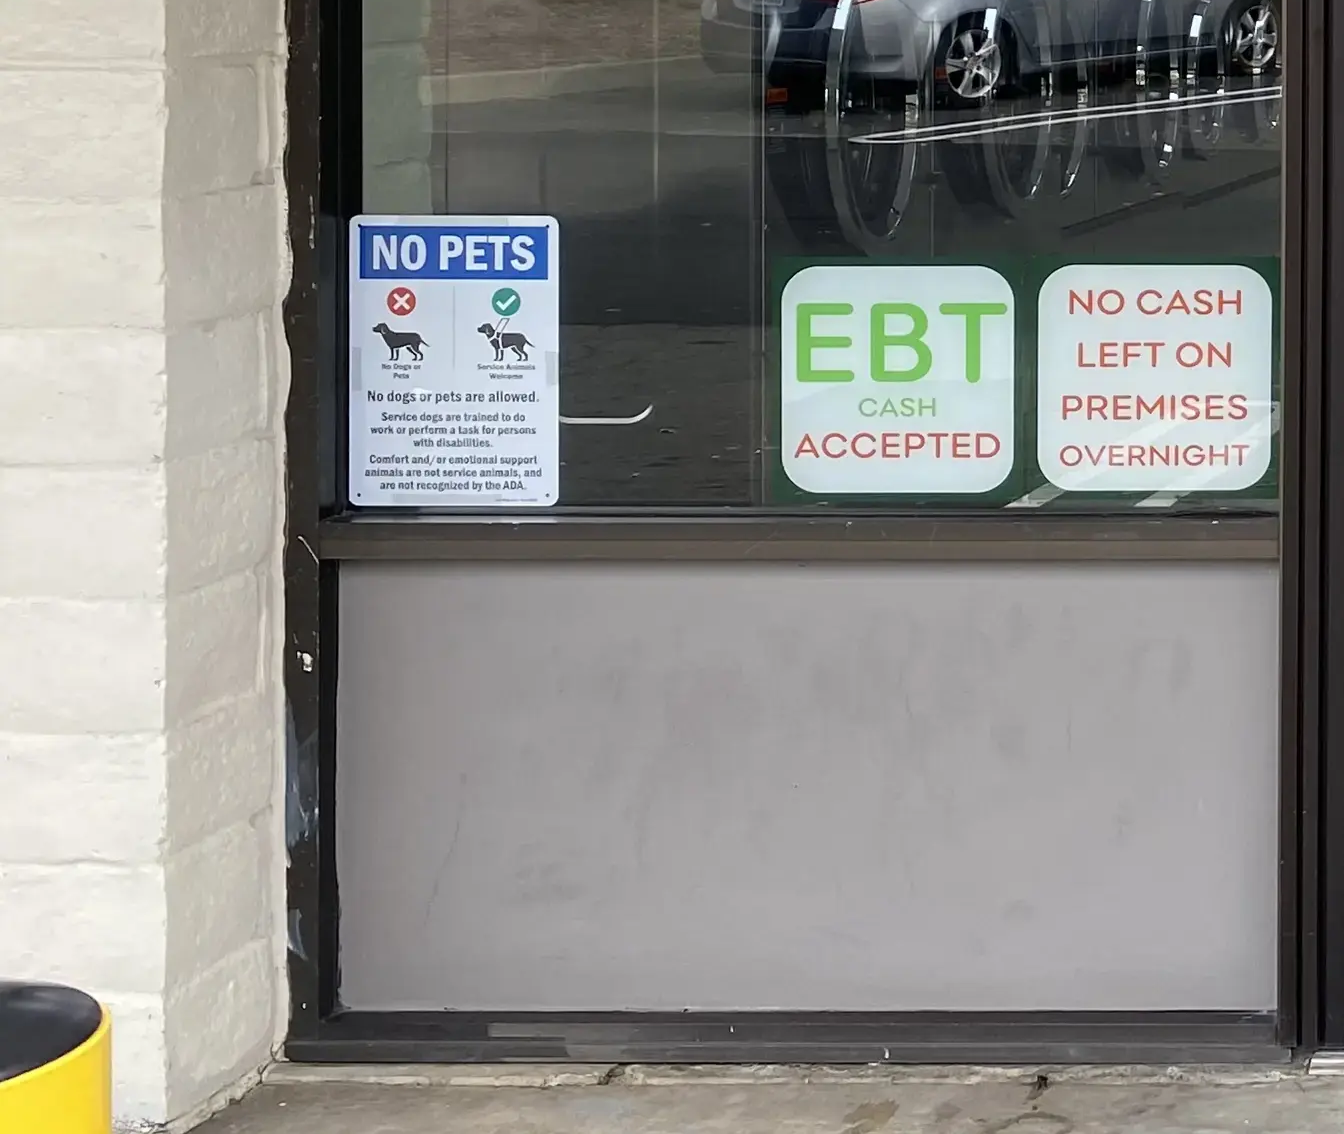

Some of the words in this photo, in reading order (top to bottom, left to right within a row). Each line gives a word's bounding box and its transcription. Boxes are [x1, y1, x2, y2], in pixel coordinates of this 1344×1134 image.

[372, 234, 427, 272] NO
[439, 234, 536, 272] PETS
[1068, 289, 1125, 316] NO
[1136, 289, 1243, 316] CASH
[795, 302, 1009, 384] EBT
[1076, 341, 1166, 369] LEFT
[1175, 341, 1233, 369] ON
[367, 391, 384, 403] No
[387, 391, 416, 404] dogs
[419, 393, 433, 403] or
[435, 392, 462, 404] pets
[466, 393, 485, 403] are
[488, 391, 540, 403] allowed.
[857, 397, 937, 418] CASH
[1060, 394, 1249, 421] PREMISES
[381, 412, 417, 422] Service
[420, 413, 443, 424] dogs
[463, 412, 499, 422] trained
[501, 412, 511, 422] to
[513, 412, 525, 422] do
[370, 425, 393, 435] work
[408, 426, 448, 436] perform
[458, 425, 479, 435] task
[482, 425, 496, 435] for
[498, 428, 536, 436] persons
[793, 432, 1001, 460] ACCEPTED
[1059, 444, 1250, 467] OVERNIGHT
[369, 455, 409, 464] Comfort
[412, 455, 446, 465] and/or
[449, 455, 498, 464] emotional
[500, 456, 538, 466] support
[365, 468, 403, 477] animals
[424, 468, 440, 477] not
[442, 468, 477, 477] service
[479, 468, 521, 479] animals,
[524, 468, 542, 477] and
[398, 481, 414, 490] not
[416, 481, 470, 492] recognized
[472, 481, 483, 492] by
[485, 481, 501, 490] the
[503, 481, 527, 490] ADA.
